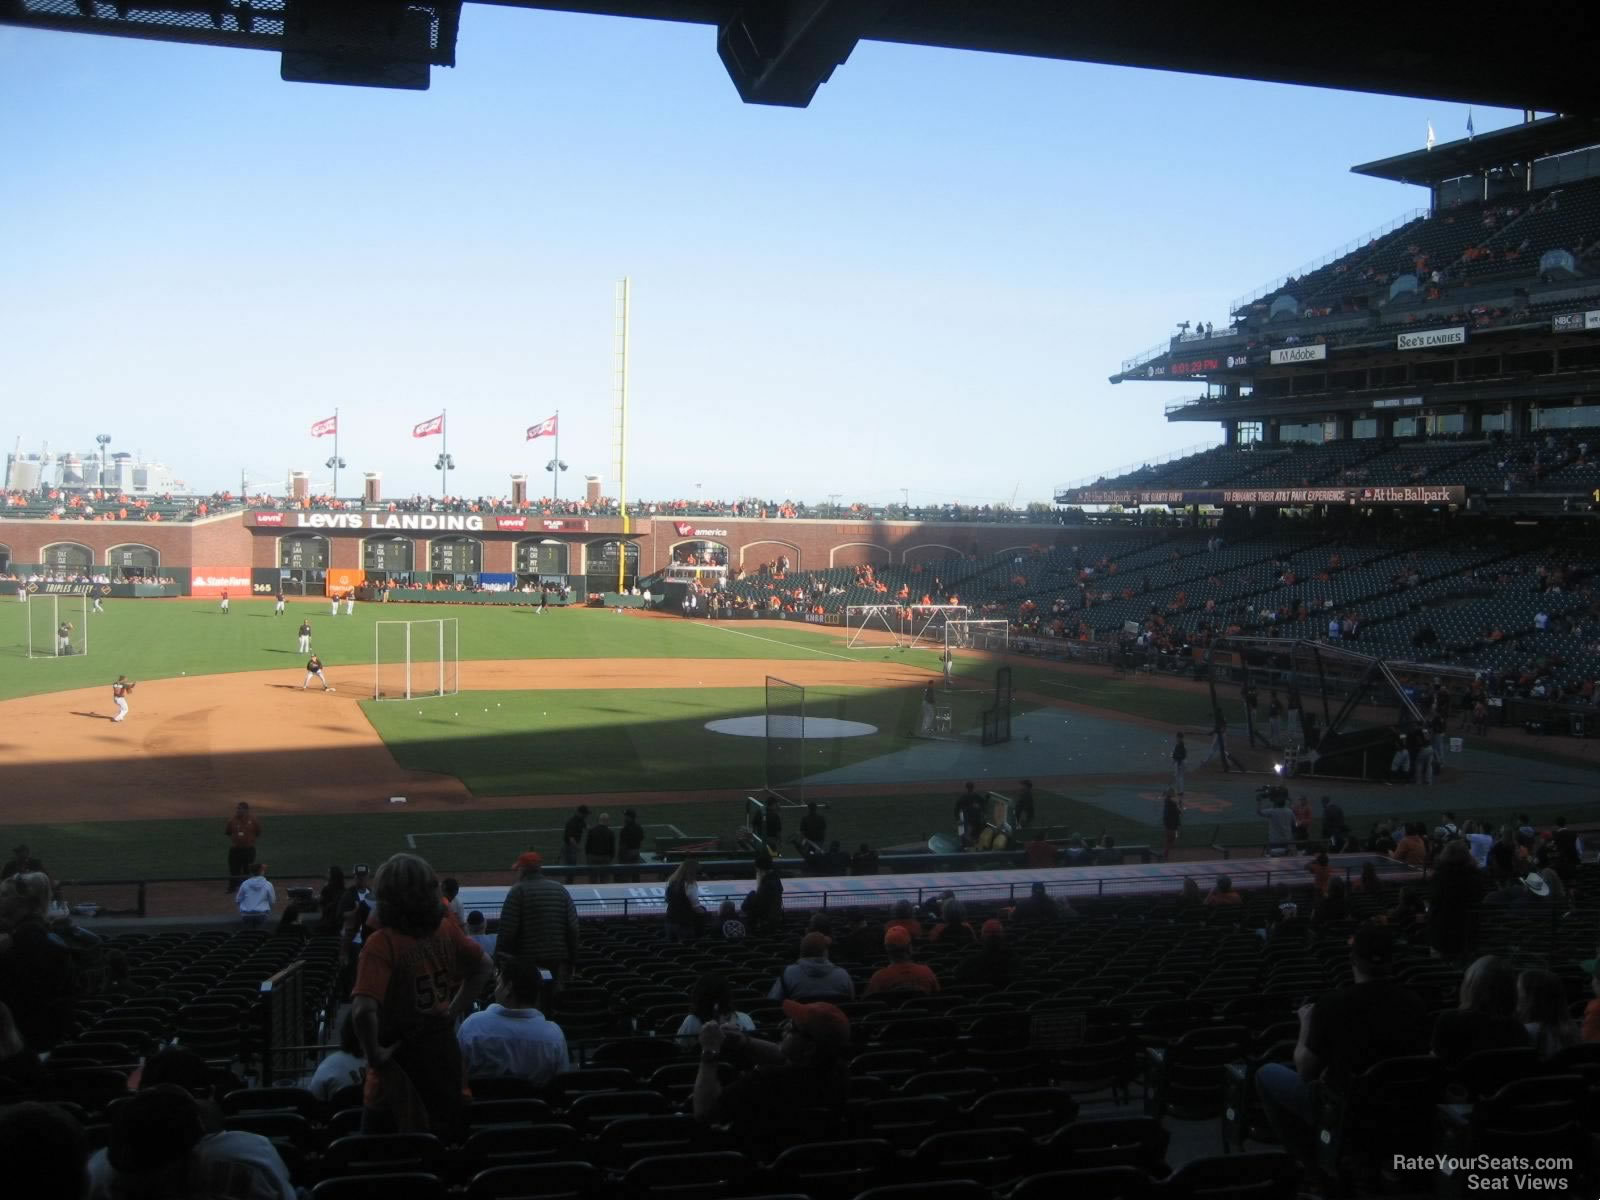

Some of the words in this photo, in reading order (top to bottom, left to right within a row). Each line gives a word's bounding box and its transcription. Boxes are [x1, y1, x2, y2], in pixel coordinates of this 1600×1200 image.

[1400, 335, 1424, 348] See's
[1427, 333, 1461, 345] CANDIES
[1290, 349, 1316, 360] Adobe
[1223, 492, 1231, 501] TO
[1231, 492, 1256, 501] ENHANCE
[1258, 492, 1275, 501] THEIR
[1275, 492, 1290, 501] AT&T
[1291, 492, 1307, 501] PARK
[1373, 489, 1386, 501] At
[1386, 488, 1403, 501] the
[1404, 487, 1450, 504] Ballpark
[298, 513, 363, 528] Levi's
[371, 514, 484, 530] LANDING
[694, 528, 727, 536] america
[46, 584, 71, 593] TRIPLES
[73, 585, 93, 594] ALLEY
[805, 614, 824, 623] KNBR
[416, 968, 449, 1011] 55
